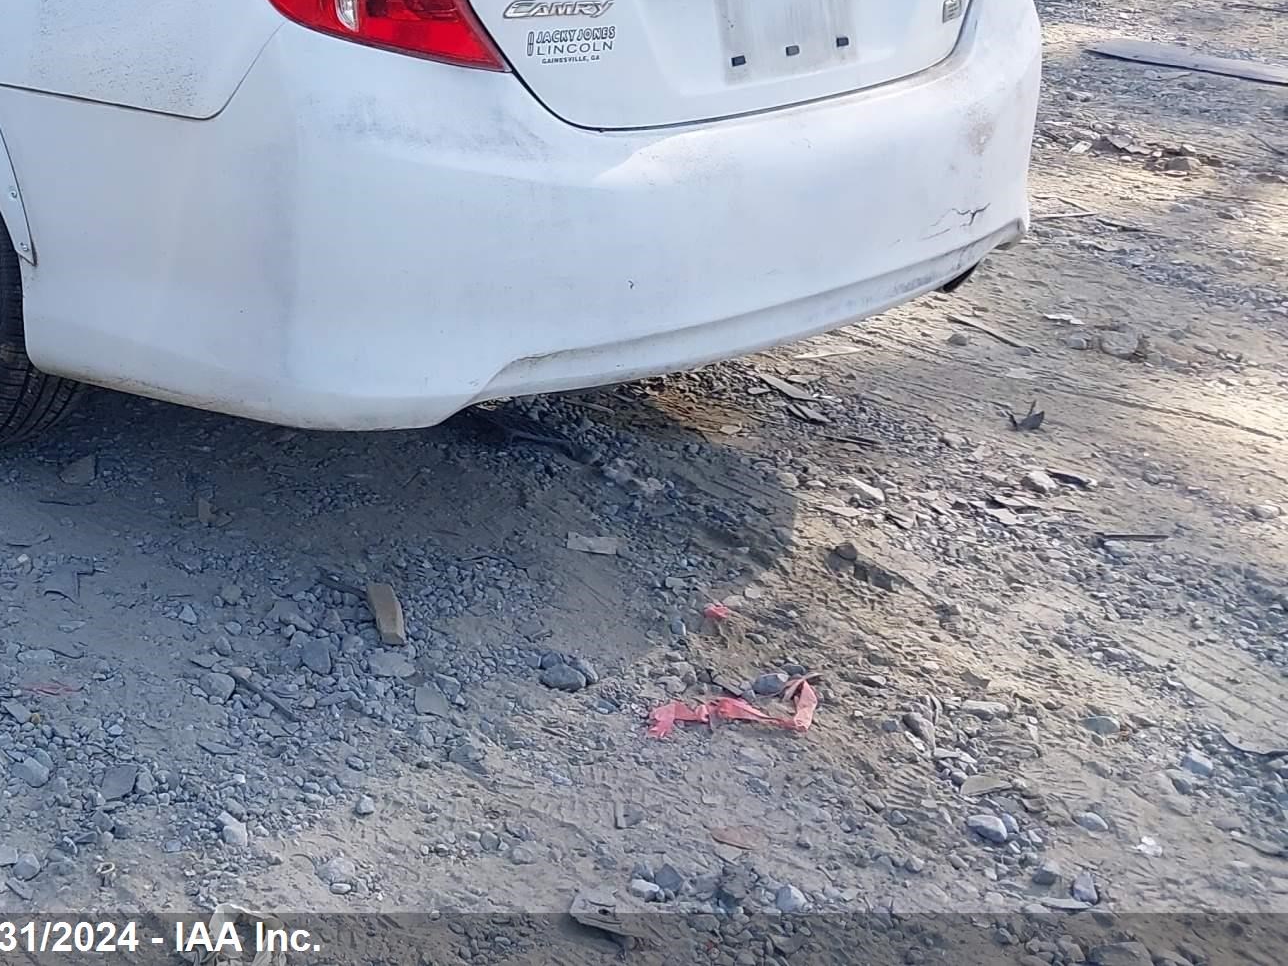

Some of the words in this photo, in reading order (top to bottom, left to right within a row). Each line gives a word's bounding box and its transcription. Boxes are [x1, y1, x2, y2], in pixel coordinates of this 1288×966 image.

[503, 0, 614, 19] CAMRY
[536, 29, 576, 44] JACKY
[577, 26, 615, 41] JONES
[537, 41, 613, 55] LINCOLN
